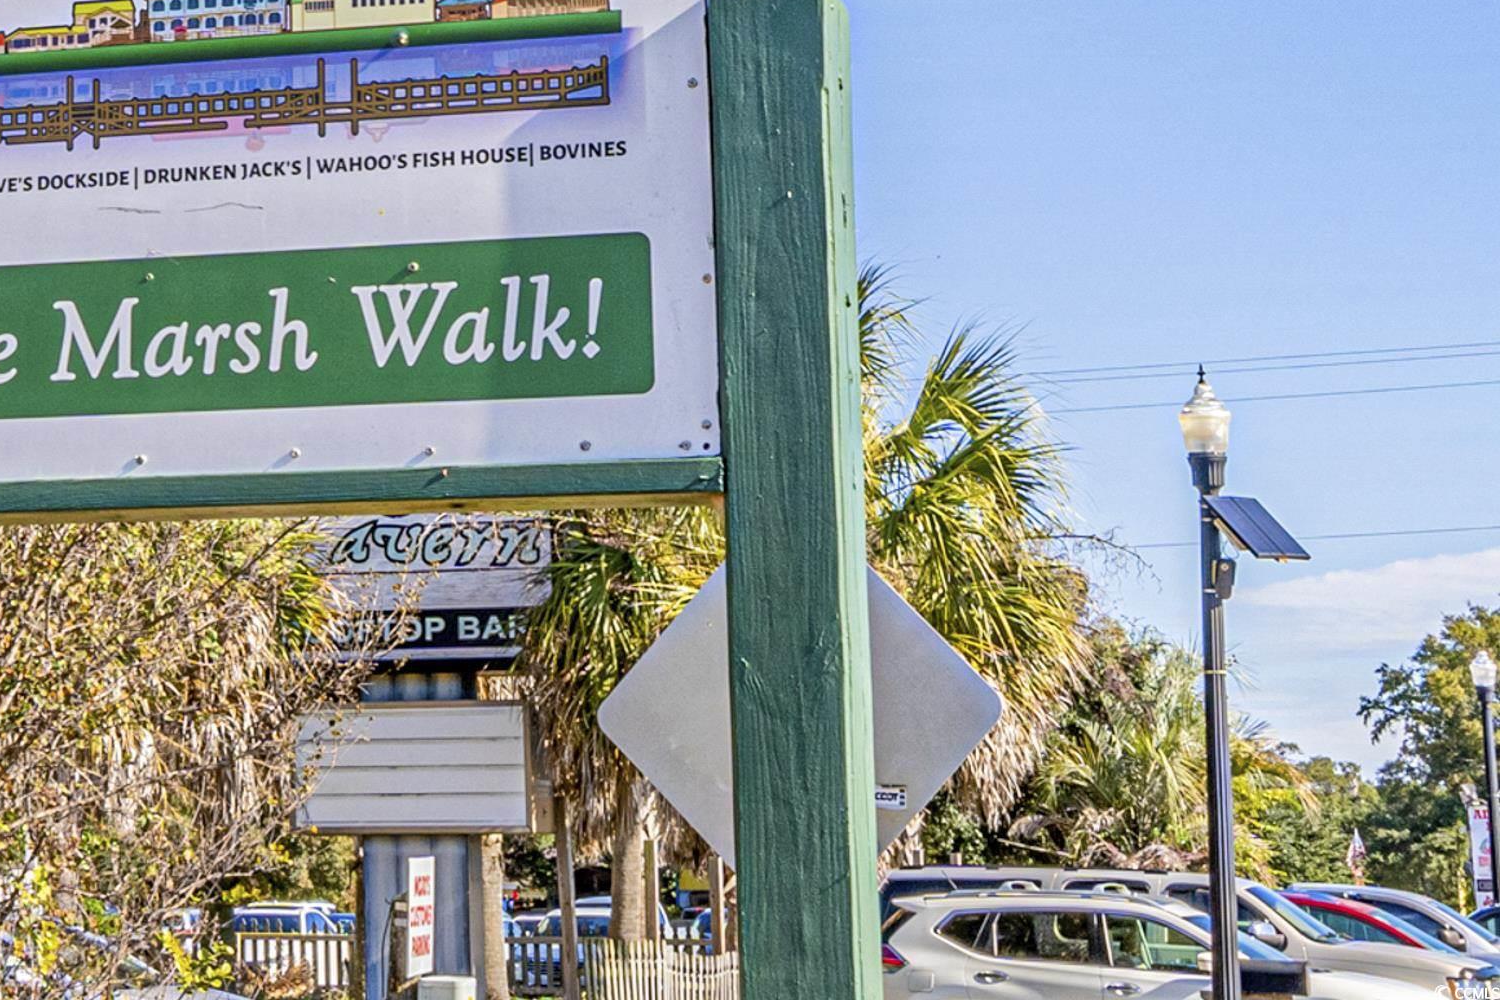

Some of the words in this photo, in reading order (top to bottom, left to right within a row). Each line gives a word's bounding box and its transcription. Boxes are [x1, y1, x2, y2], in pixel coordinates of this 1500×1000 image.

[316, 154, 408, 174] WAHOO'S
[412, 150, 456, 168] FISH
[461, 146, 528, 166] HOUSE
[539, 140, 627, 161] BOVINES
[37, 170, 130, 191] DOCKSIDE
[144, 164, 238, 185] DRUNKEN
[240, 160, 302, 180] JACK'S
[49, 286, 318, 383] Marsh
[351, 274, 604, 369] Walk!
